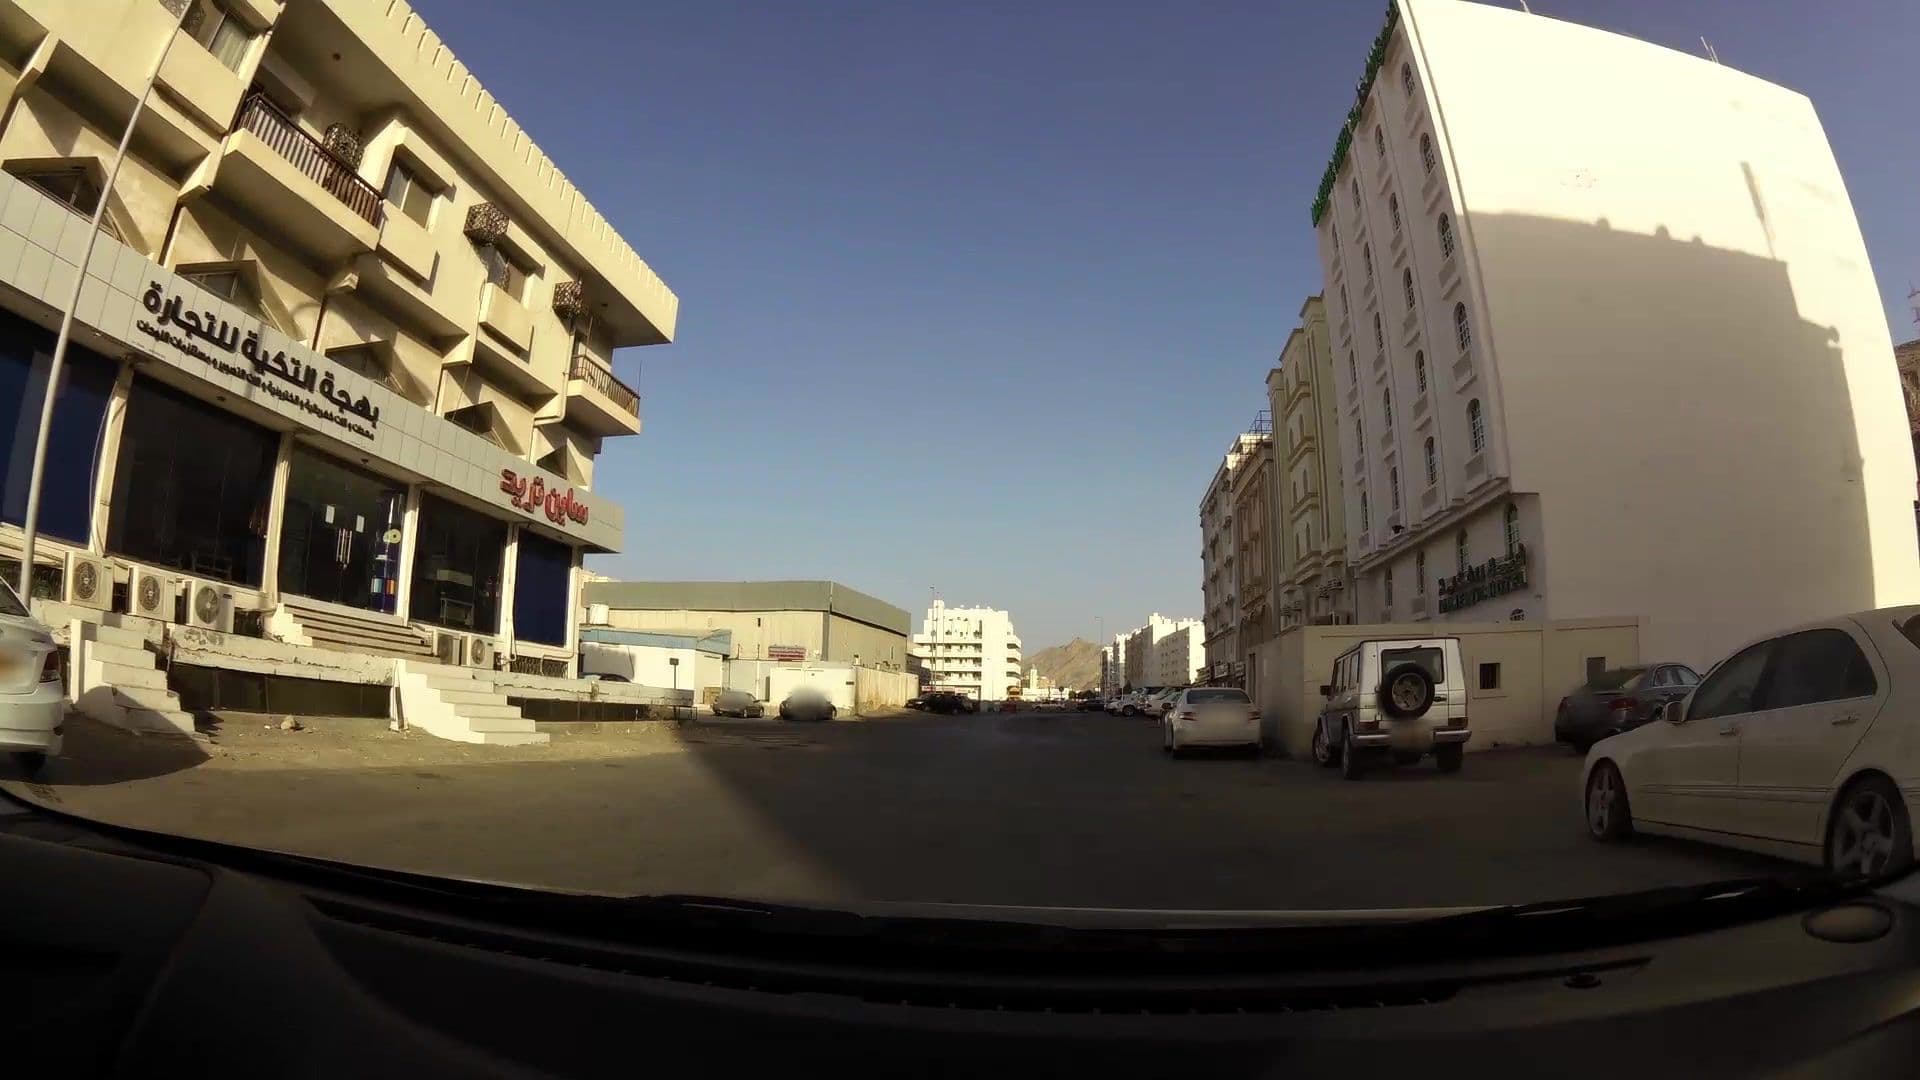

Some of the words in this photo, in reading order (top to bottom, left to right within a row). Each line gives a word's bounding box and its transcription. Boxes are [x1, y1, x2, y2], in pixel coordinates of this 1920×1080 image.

[142, 281, 240, 354] للتجارة
[319, 370, 379, 430] بهجة
[500, 468, 545, 514] تريد
[544, 487, 589, 527] ساين
